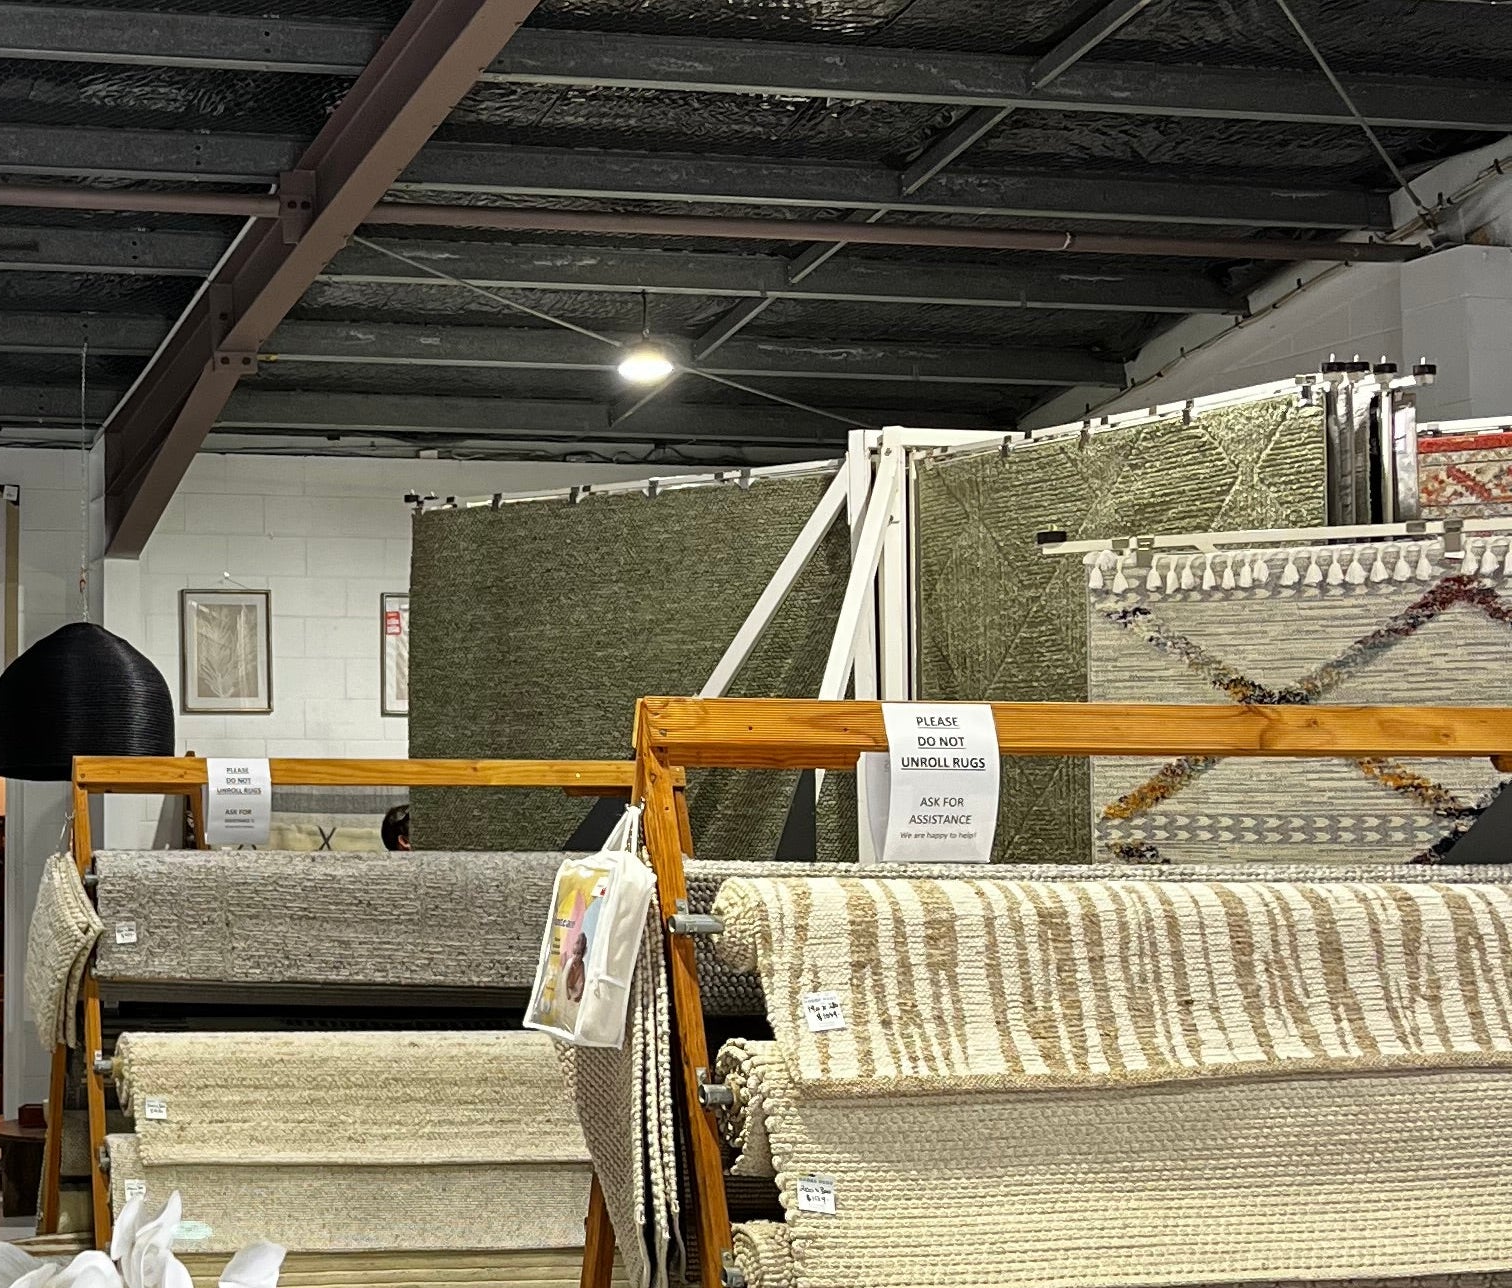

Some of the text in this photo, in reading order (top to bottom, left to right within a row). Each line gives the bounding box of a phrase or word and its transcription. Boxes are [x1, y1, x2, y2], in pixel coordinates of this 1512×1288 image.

[916, 716, 959, 727] PLEASE
[917, 736, 965, 747] DO NOT
[901, 757, 986, 769] UNROLL RUGS
[920, 797, 965, 807] ASK FOR
[908, 814, 973, 825] ASSISTANCE
[927, 832, 948, 840] happy
